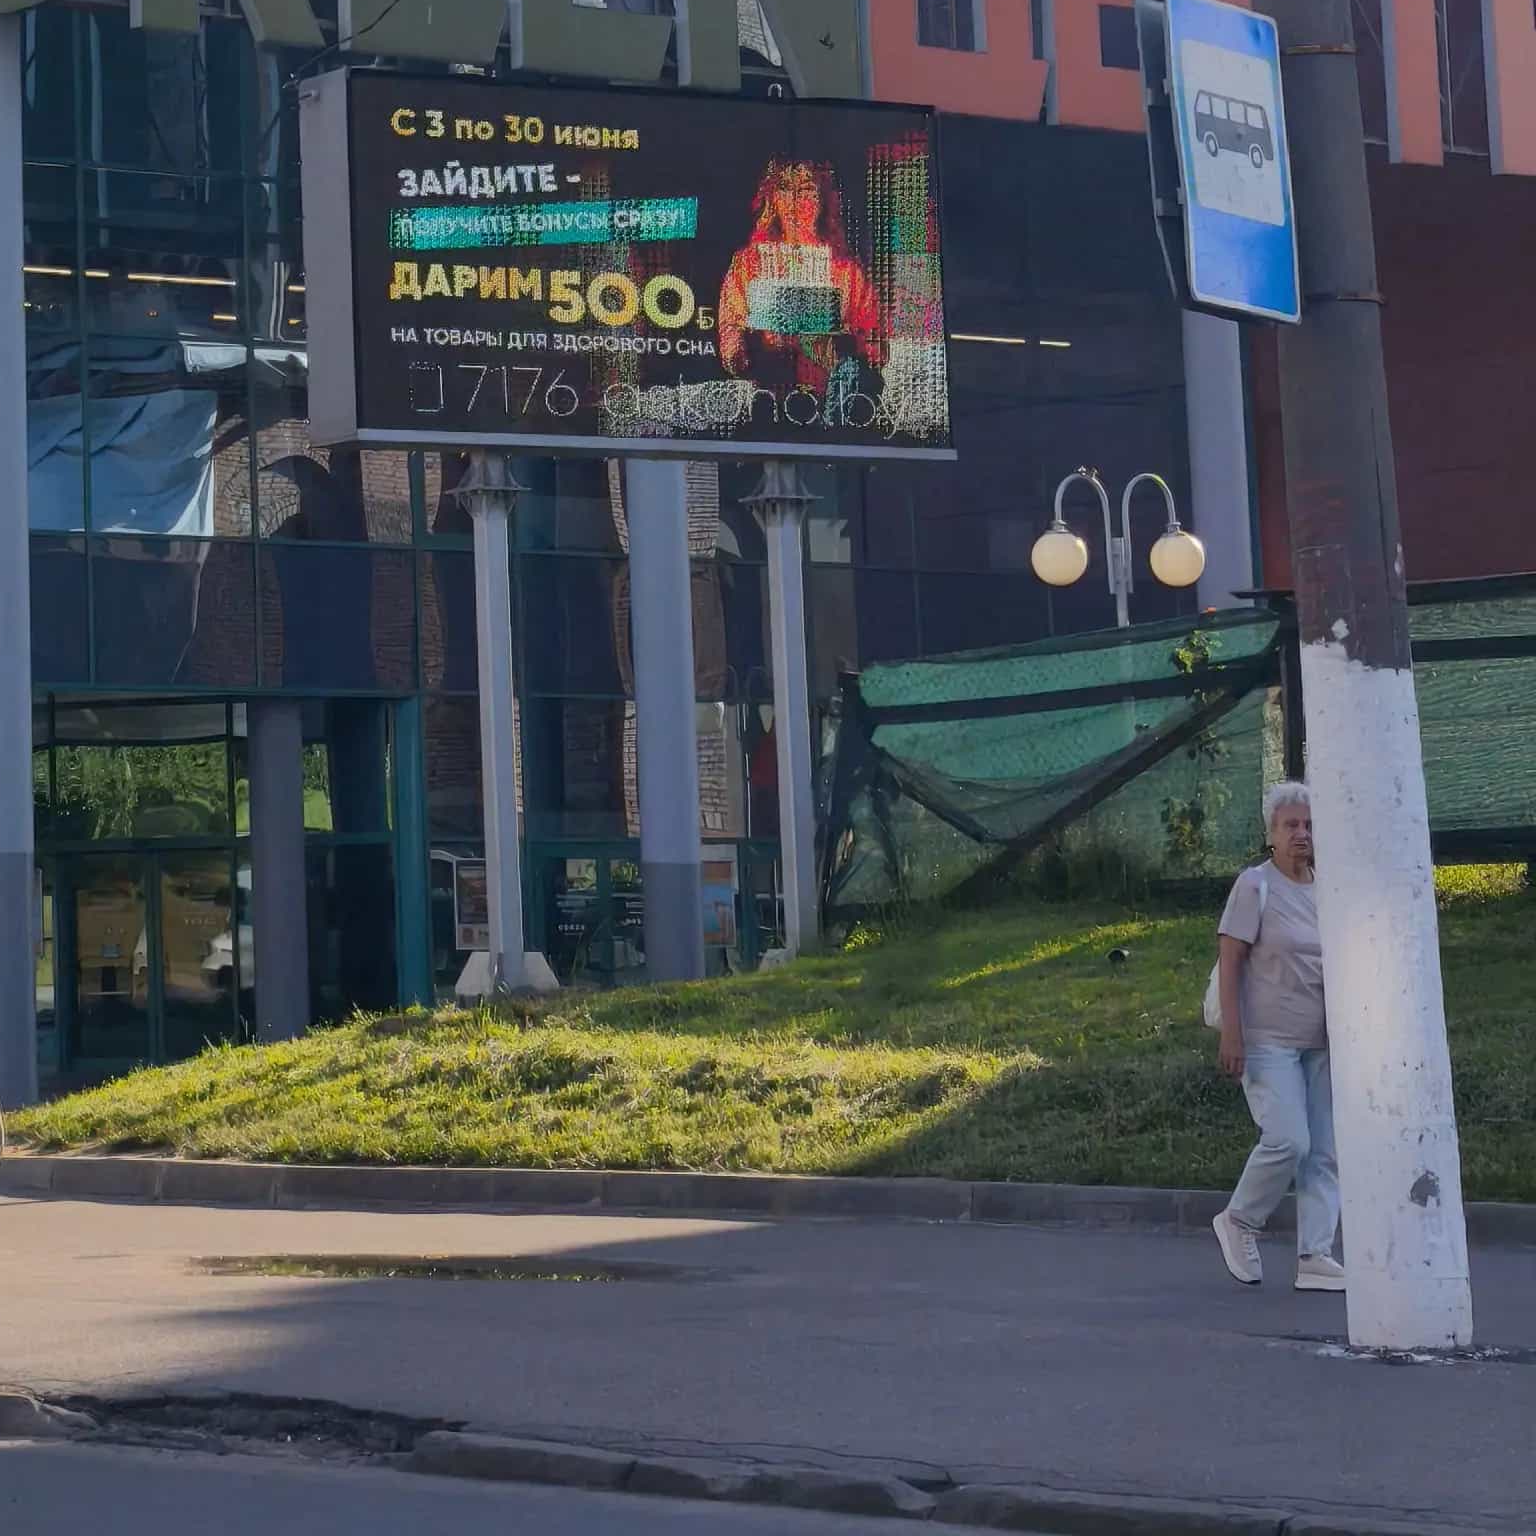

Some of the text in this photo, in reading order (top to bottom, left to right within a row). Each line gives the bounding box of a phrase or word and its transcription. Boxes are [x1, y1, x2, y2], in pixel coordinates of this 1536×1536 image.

[390, 108, 639, 151] С 3 по 30 июня
[397, 159, 558, 199] ЗАЙДИТЕ
[389, 261, 543, 301] ДАРИМ
[546, 270, 695, 330] 500
[391, 327, 716, 356] НА ТОВАРЫ ДЛЯ ЗДОРОВОГО СНА
